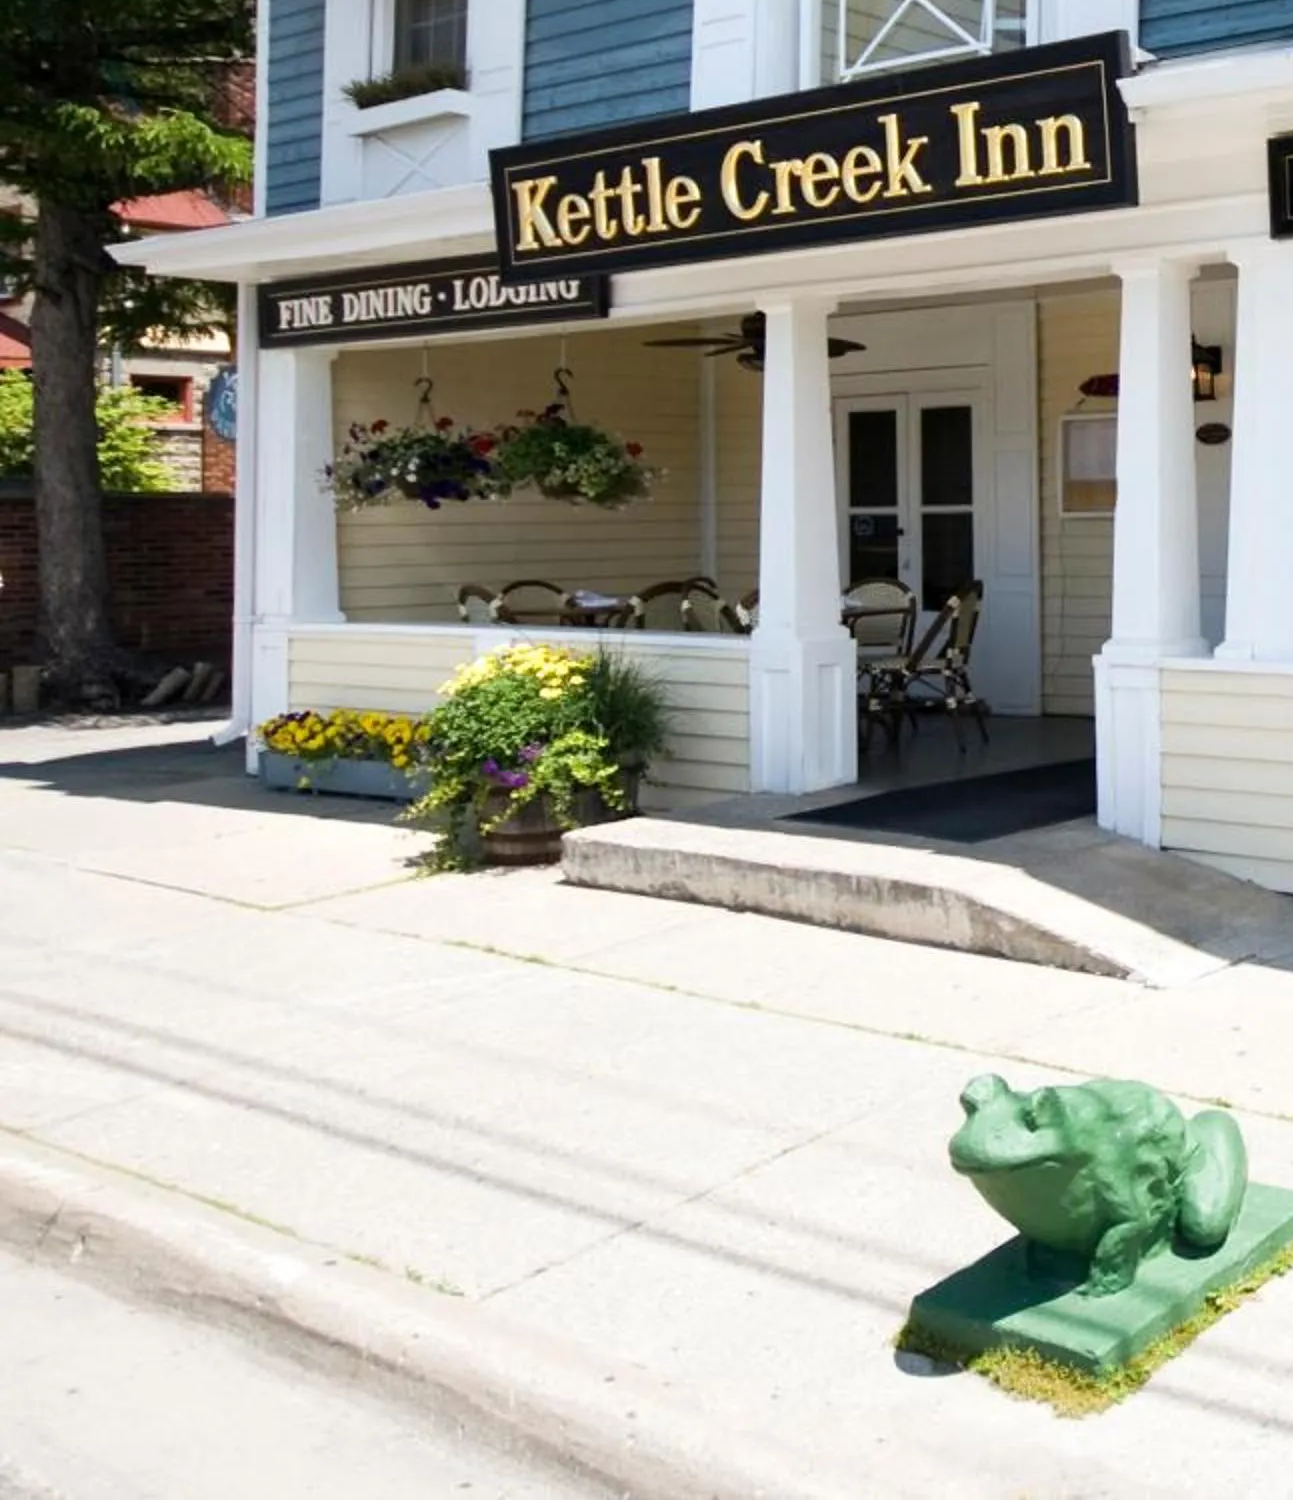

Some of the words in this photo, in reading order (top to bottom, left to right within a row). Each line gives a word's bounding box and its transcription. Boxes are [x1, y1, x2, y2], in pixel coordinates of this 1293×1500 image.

[511, 156, 702, 252] Kettle
[720, 113, 932, 220] Creek
[949, 100, 1092, 187] Inn
[278, 296, 333, 330] FINE
[341, 283, 433, 323] DINING
